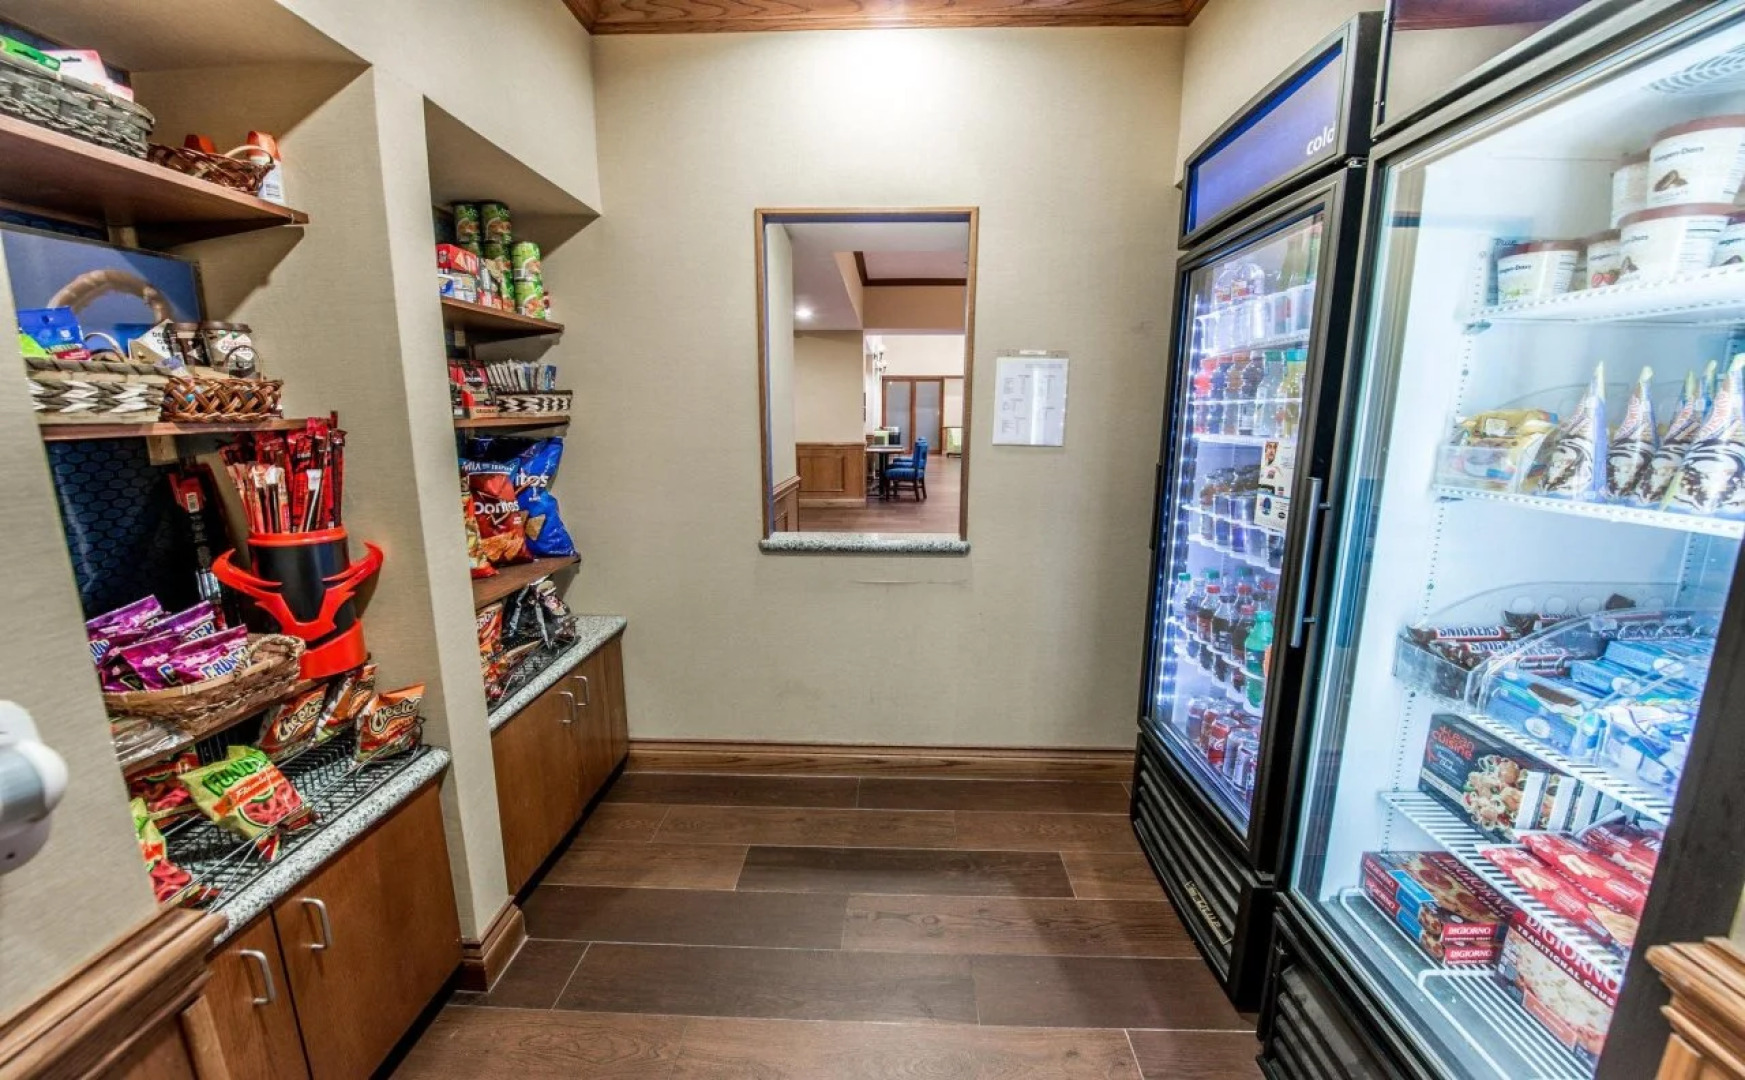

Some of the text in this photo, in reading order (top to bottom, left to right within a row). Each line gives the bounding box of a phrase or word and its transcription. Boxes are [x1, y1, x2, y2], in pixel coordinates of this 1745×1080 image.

[1306, 121, 1336, 155] cold
[515, 470, 549, 489] itos
[473, 501, 519, 515] Doritos
[1439, 627, 1500, 637] SNICKERS
[370, 699, 419, 733] Cheeto
[1448, 926, 1491, 935] DIGIORNO
[1450, 949, 1492, 958] DIGIORNO
[1517, 924, 1616, 1006] TRADITIONAL CRUS
